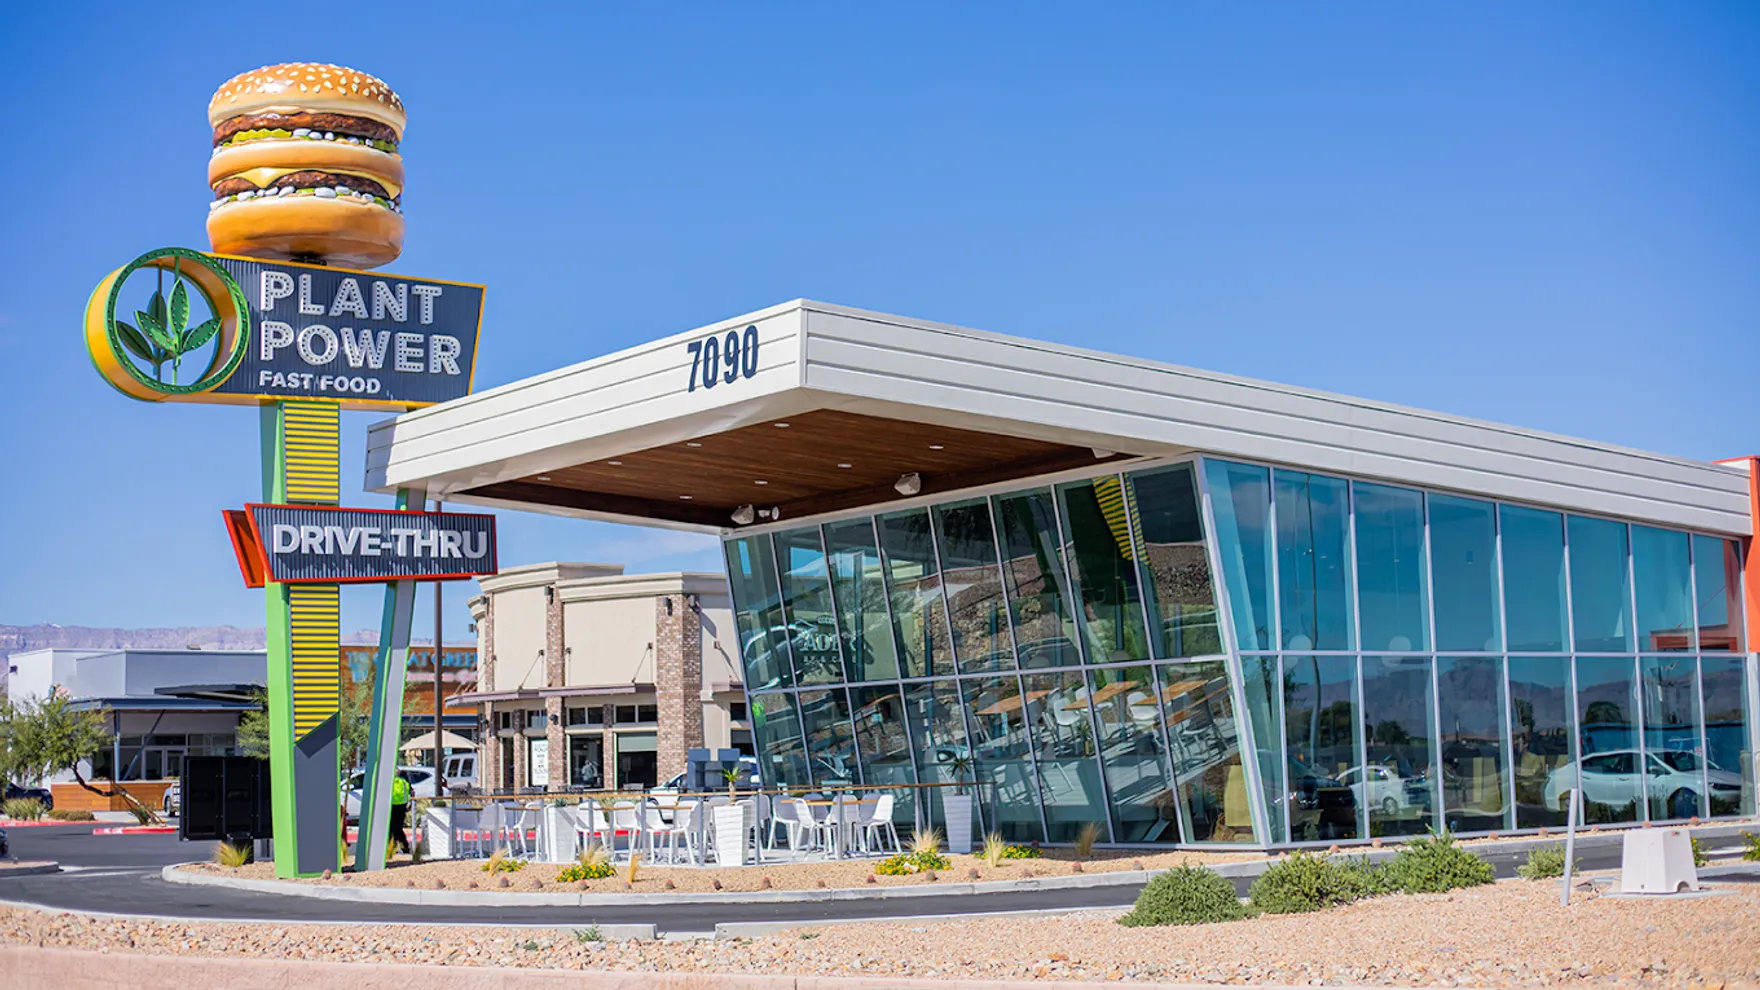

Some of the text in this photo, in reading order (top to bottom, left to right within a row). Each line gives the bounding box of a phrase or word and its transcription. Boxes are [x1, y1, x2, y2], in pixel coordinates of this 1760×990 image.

[260, 270, 443, 325] PLANT
[260, 320, 461, 375] POWER
[687, 325, 758, 393] 7090
[259, 370, 381, 394] FAST FOOD
[273, 524, 487, 559] DRIVE-THRU
